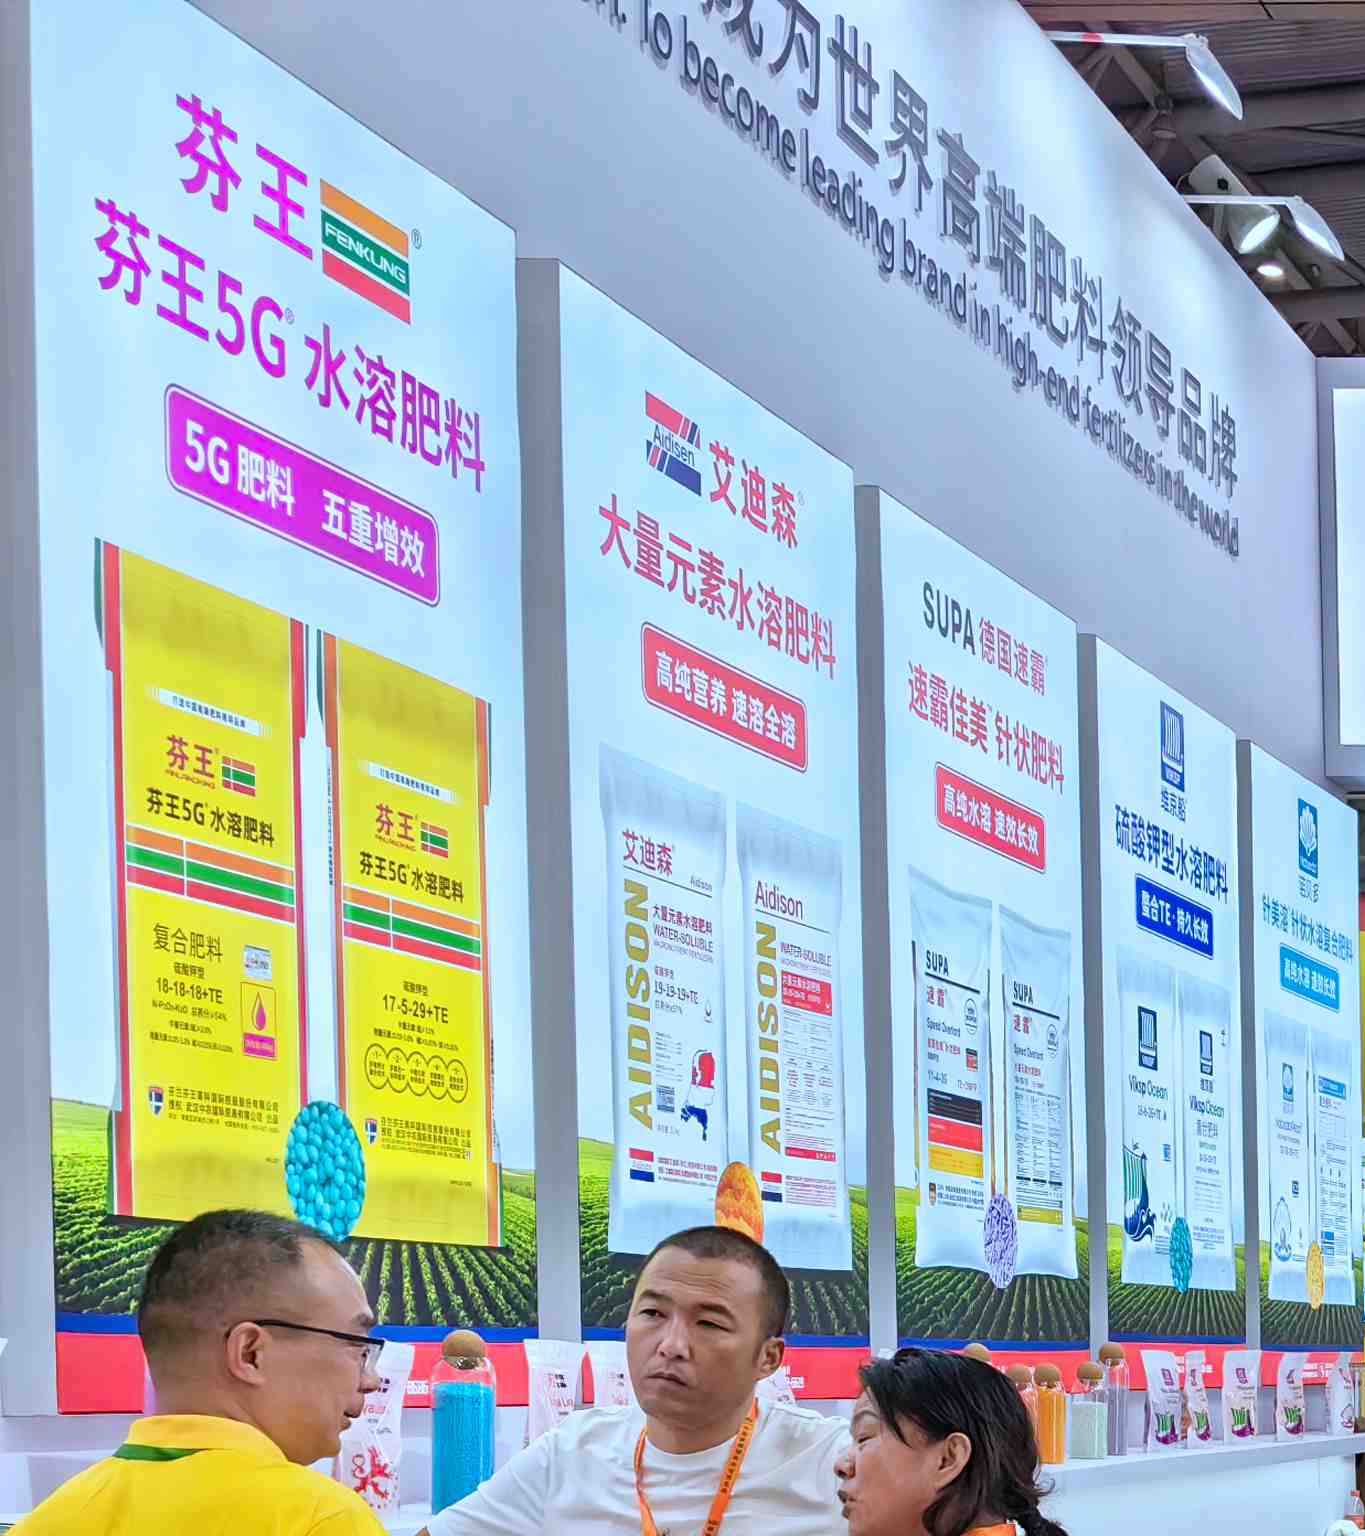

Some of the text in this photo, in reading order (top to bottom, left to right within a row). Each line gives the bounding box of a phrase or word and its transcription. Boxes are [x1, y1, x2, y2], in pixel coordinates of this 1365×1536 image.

[175, 93, 313, 260] 芬王
[680, 15, 797, 173] become
[800, 128, 895, 275] leading
[901, 218, 967, 324] brand
[971, 283, 991, 346] in
[997, 305, 1080, 418] high-end
[1083, 386, 1156, 484] fertilizers
[1199, 501, 1240, 557] world
[304, 322, 487, 493] 水溶肥料
[321, 489, 426, 579] 五重增效
[709, 439, 798, 549] 艾迪森
[600, 494, 837, 681] 大量元素水溶肥料
[923, 582, 976, 656] SUPA
[166, 733, 216, 778] 芬王
[210, 806, 275, 848] 水溶肥料
[376, 803, 415, 842] 芬王
[1115, 803, 1229, 905] 硫酸钾型水溶肥料
[755, 879, 803, 920] Aidison
[153, 922, 223, 962] 复合肥料
[926, 949, 949, 976] SUPA
[156, 977, 224, 1004] 18-18-18+TE
[623, 878, 654, 1131] AIDISON
[1013, 980, 1034, 1005] SUPA
[755, 920, 782, 1154] AIDISON
